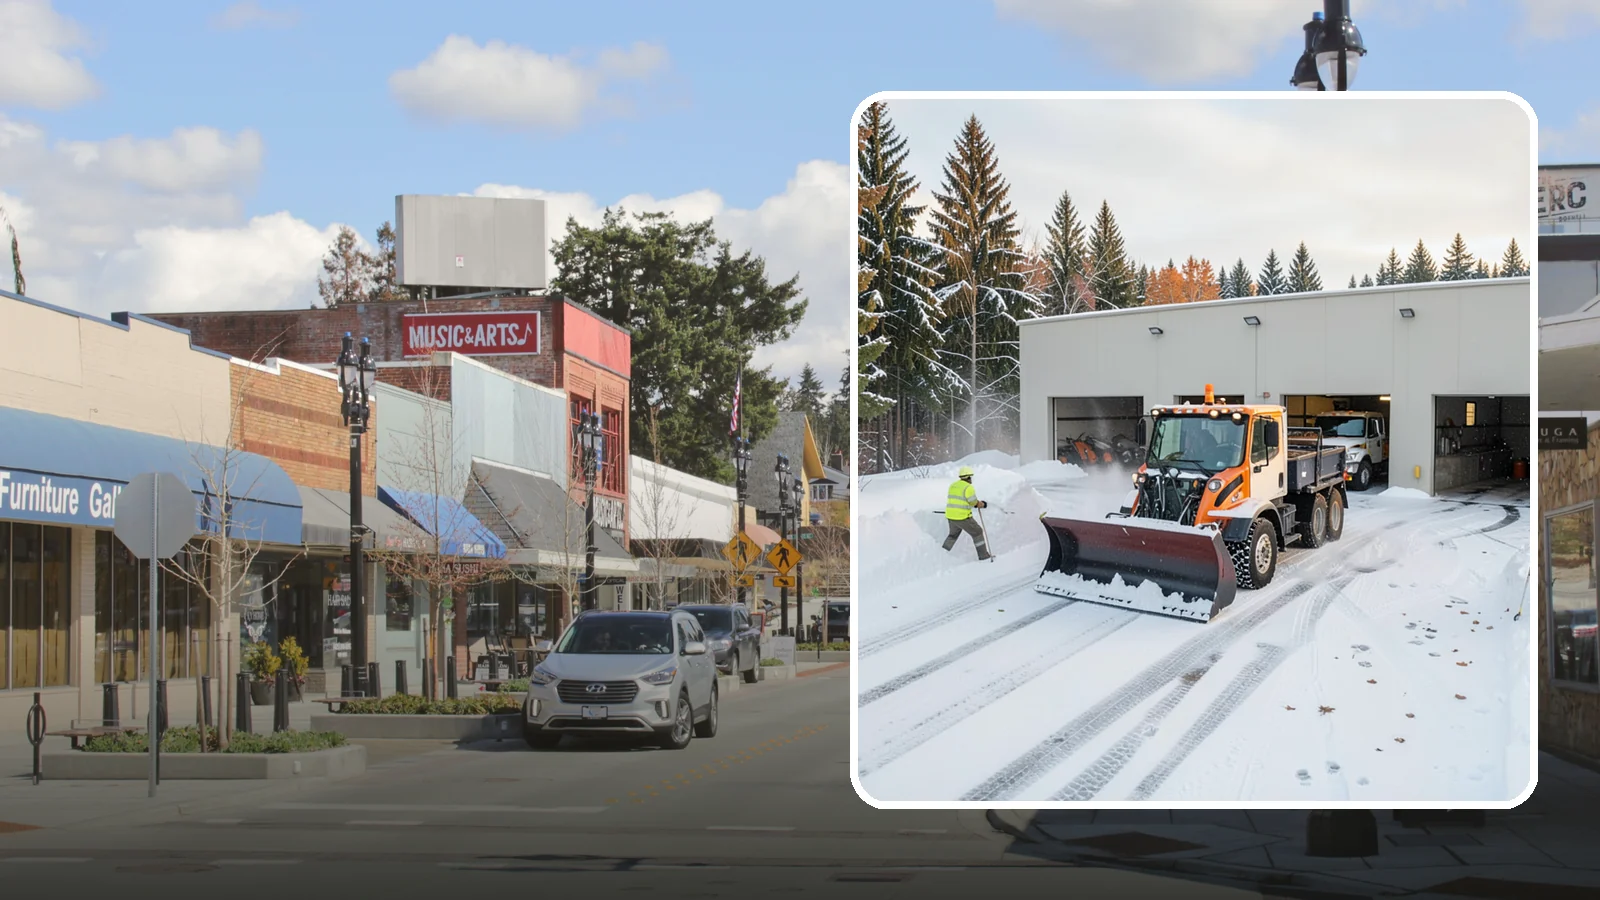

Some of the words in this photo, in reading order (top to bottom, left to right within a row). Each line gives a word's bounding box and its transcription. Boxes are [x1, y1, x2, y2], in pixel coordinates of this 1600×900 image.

[0, 471, 79, 515] Furniture
[89, 482, 122, 519] Gal
[453, 563, 479, 575] SUSHI
